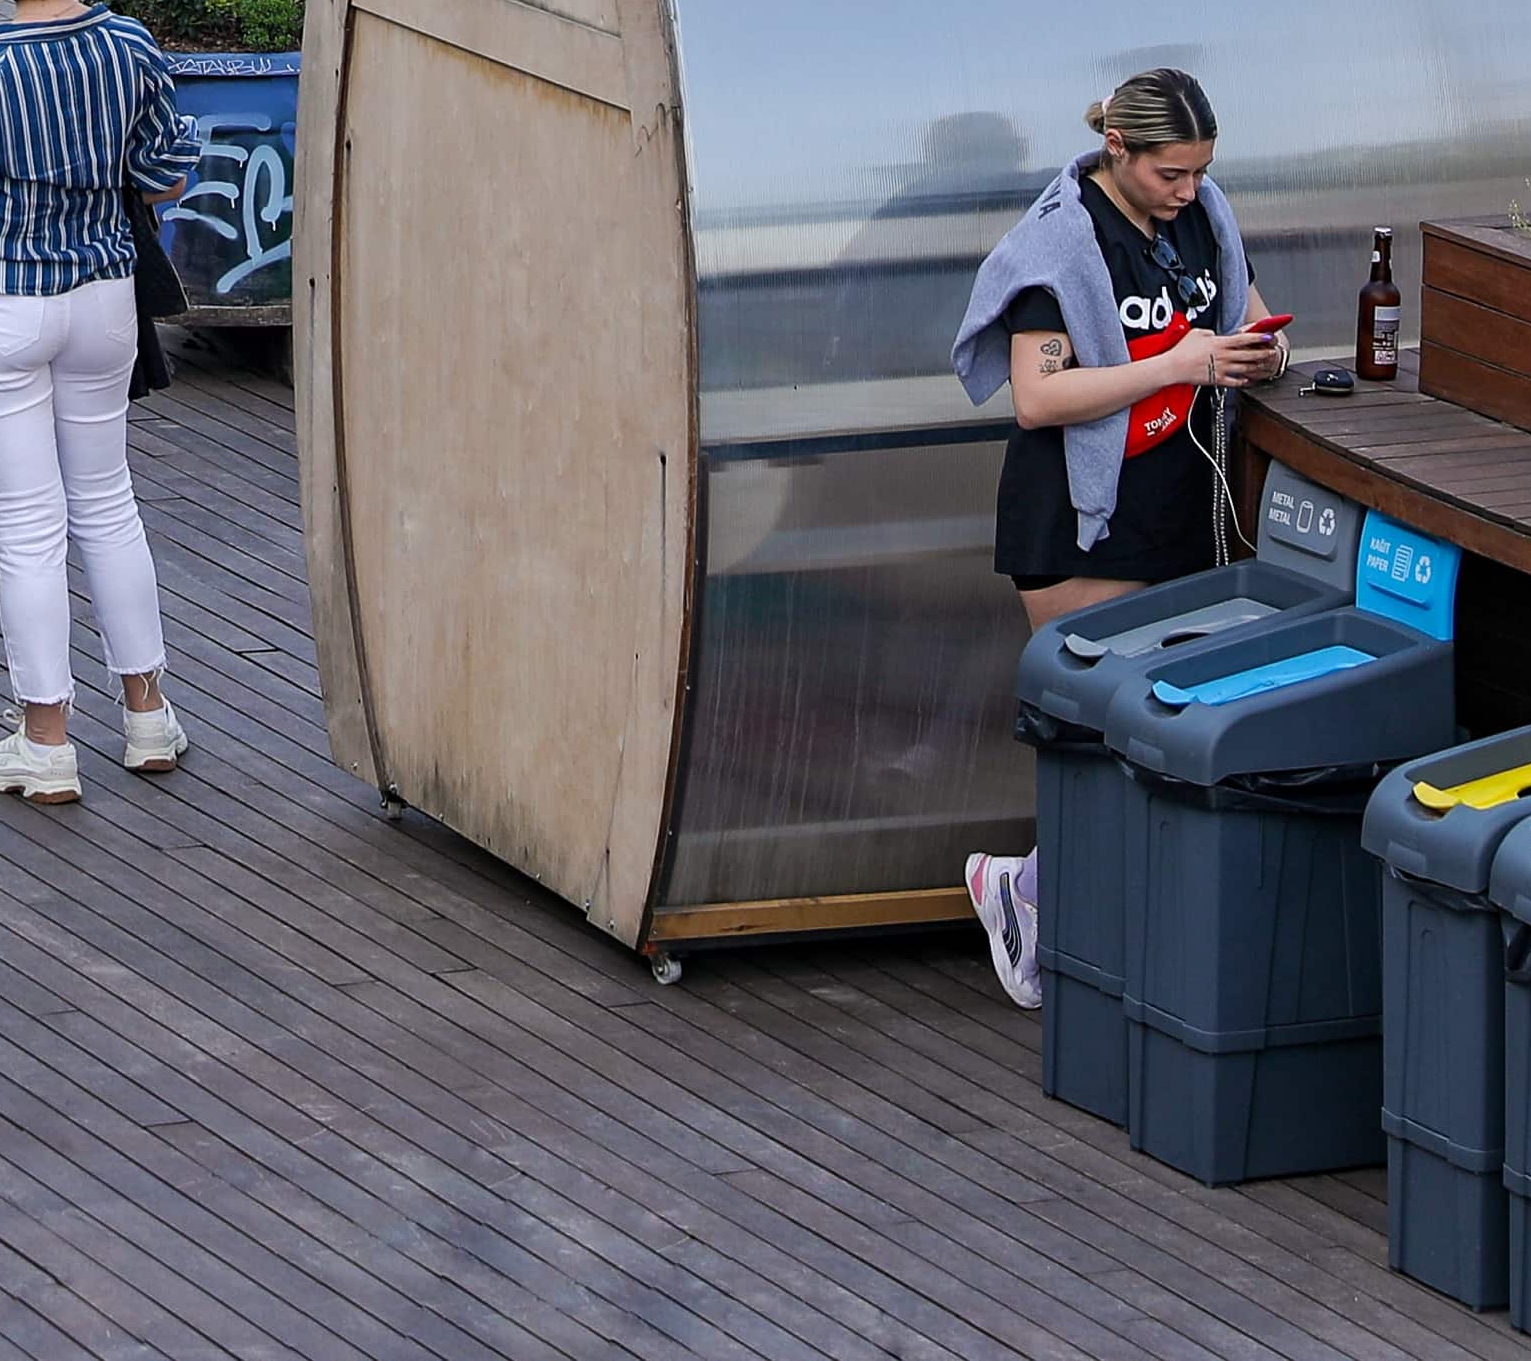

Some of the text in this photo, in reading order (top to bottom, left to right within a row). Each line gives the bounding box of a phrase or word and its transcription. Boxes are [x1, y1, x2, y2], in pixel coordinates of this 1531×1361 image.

[1272, 491, 1296, 510] METAL
[1268, 507, 1291, 526] METAL
[1366, 553, 1389, 572] PAPER
